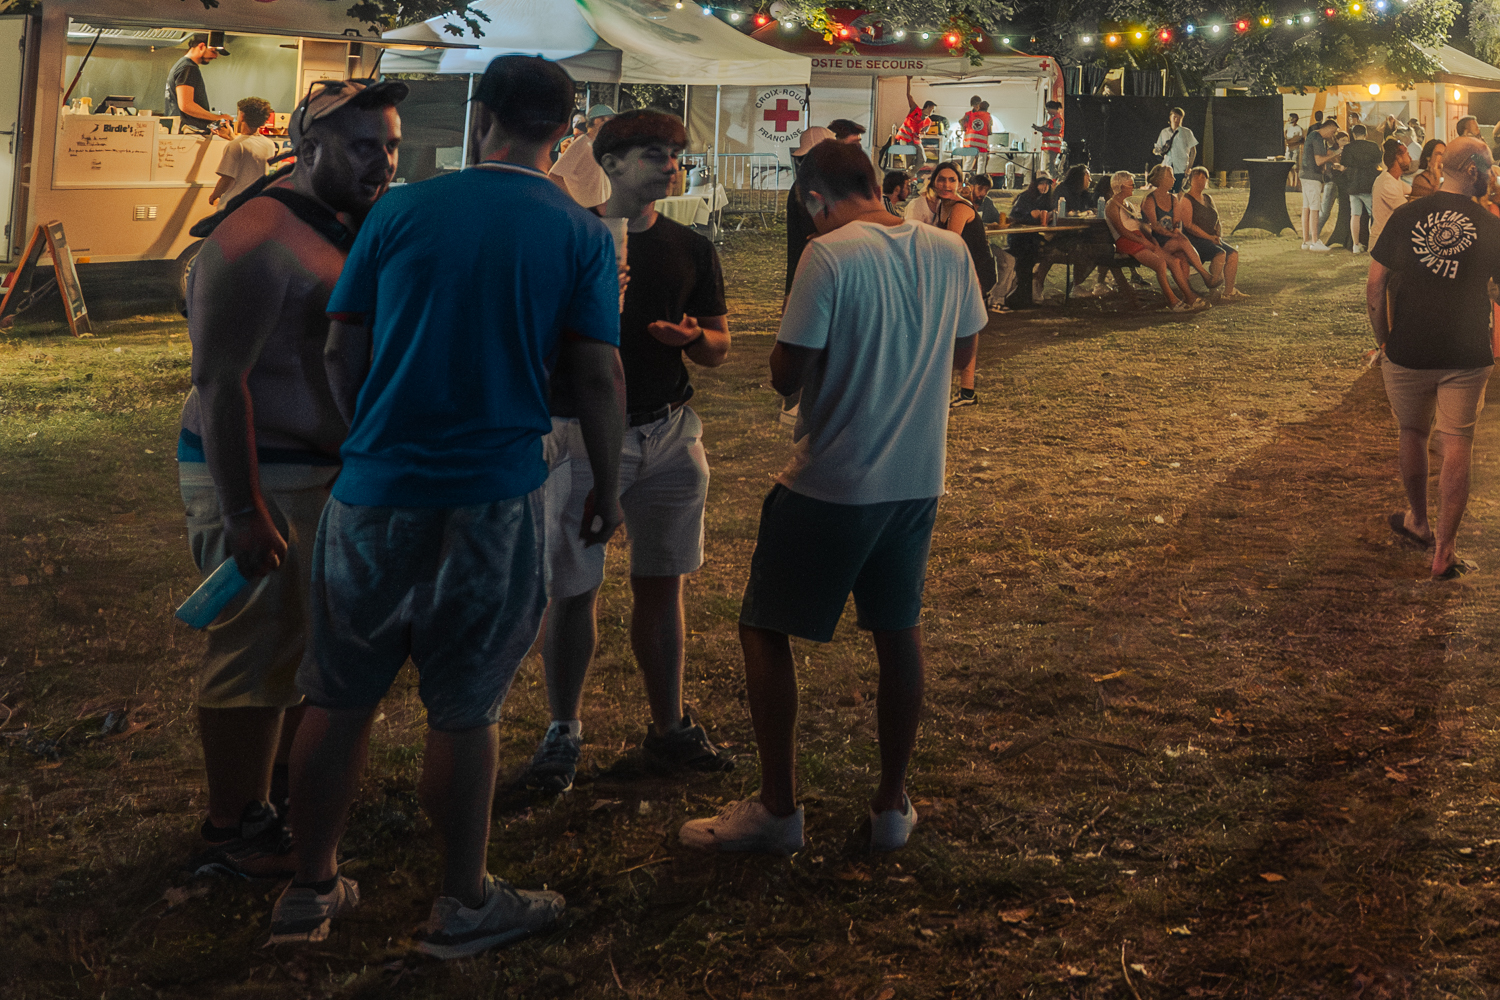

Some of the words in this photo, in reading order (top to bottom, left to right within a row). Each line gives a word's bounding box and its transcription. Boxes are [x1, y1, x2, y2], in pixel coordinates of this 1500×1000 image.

[811, 58, 843, 68] OSTE
[846, 59, 863, 69] DE
[866, 60, 924, 69] SECOURS
[755, 89, 805, 109] CROIX-ROUG
[758, 127, 803, 143] FRANÇAISE
